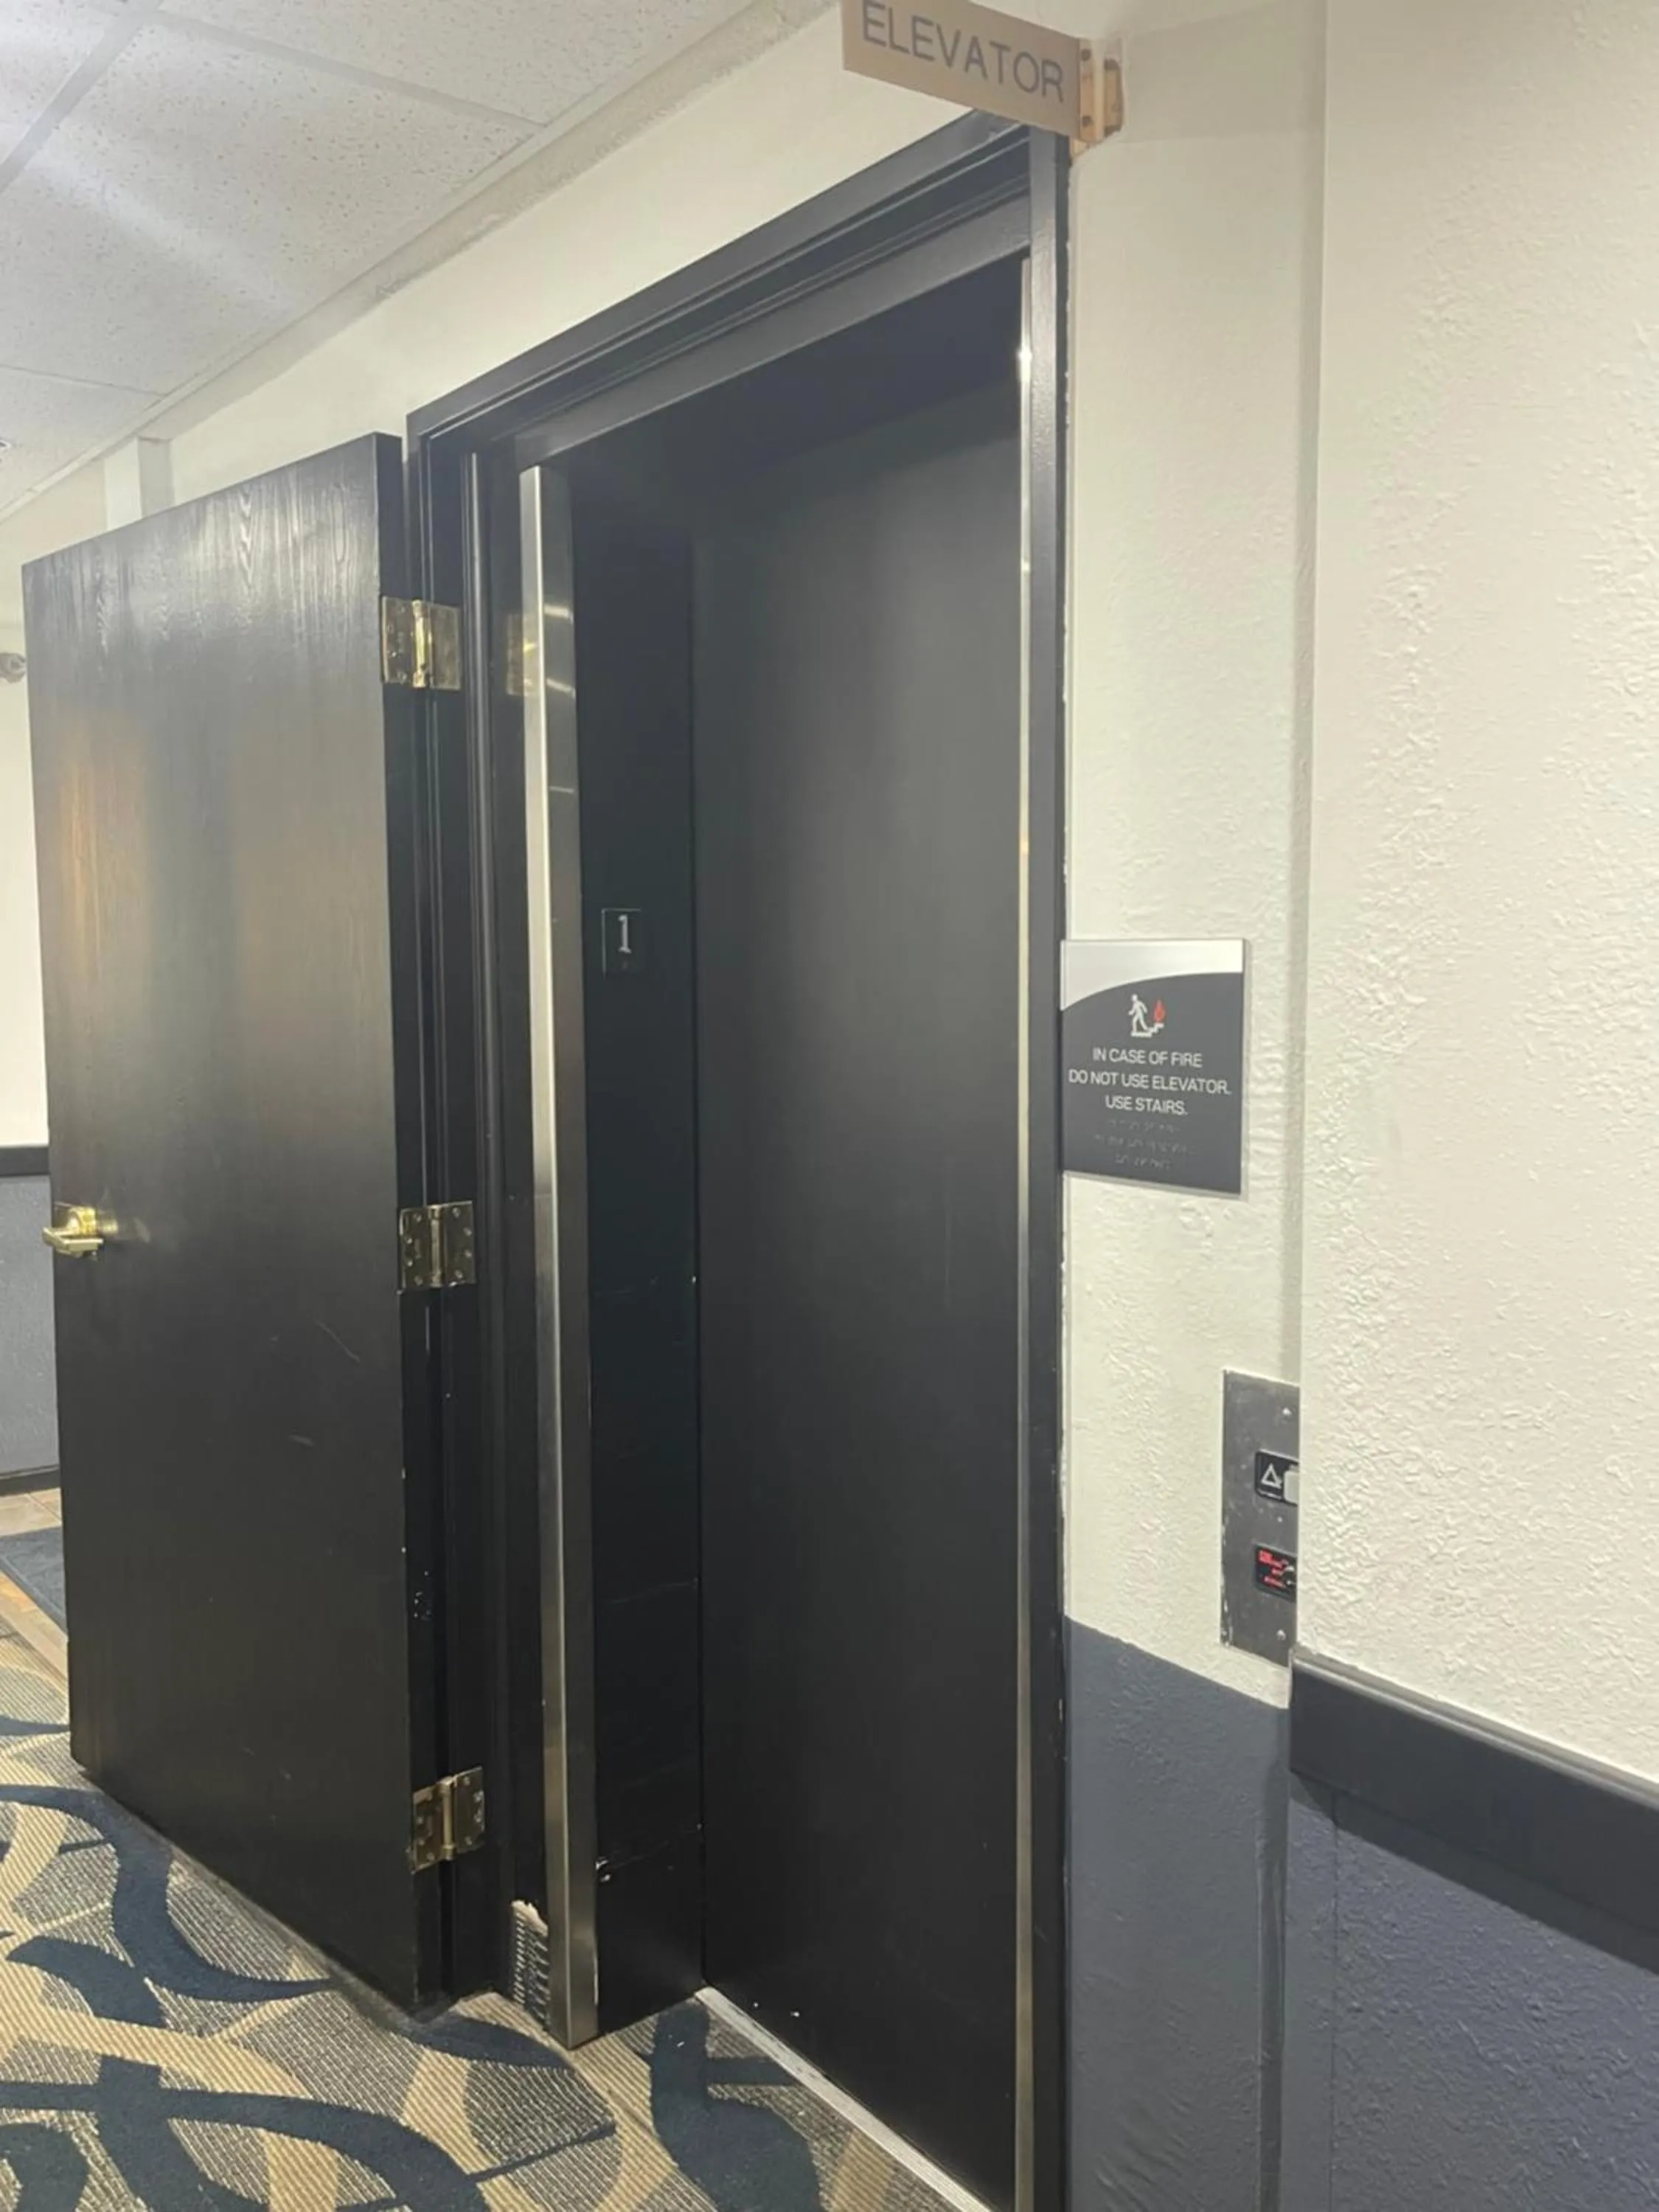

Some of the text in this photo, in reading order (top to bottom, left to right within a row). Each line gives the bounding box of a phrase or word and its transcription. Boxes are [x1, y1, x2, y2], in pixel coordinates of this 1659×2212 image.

[863, 0, 1064, 104] ELEVATOR
[618, 914, 632, 954] 1
[1092, 1047, 1203, 1068] IN CASE OF FIRE
[1068, 1068, 1233, 1095] DO NOT USE ELEVATOR.
[1105, 1094, 1189, 1116] USE STAIRS.
